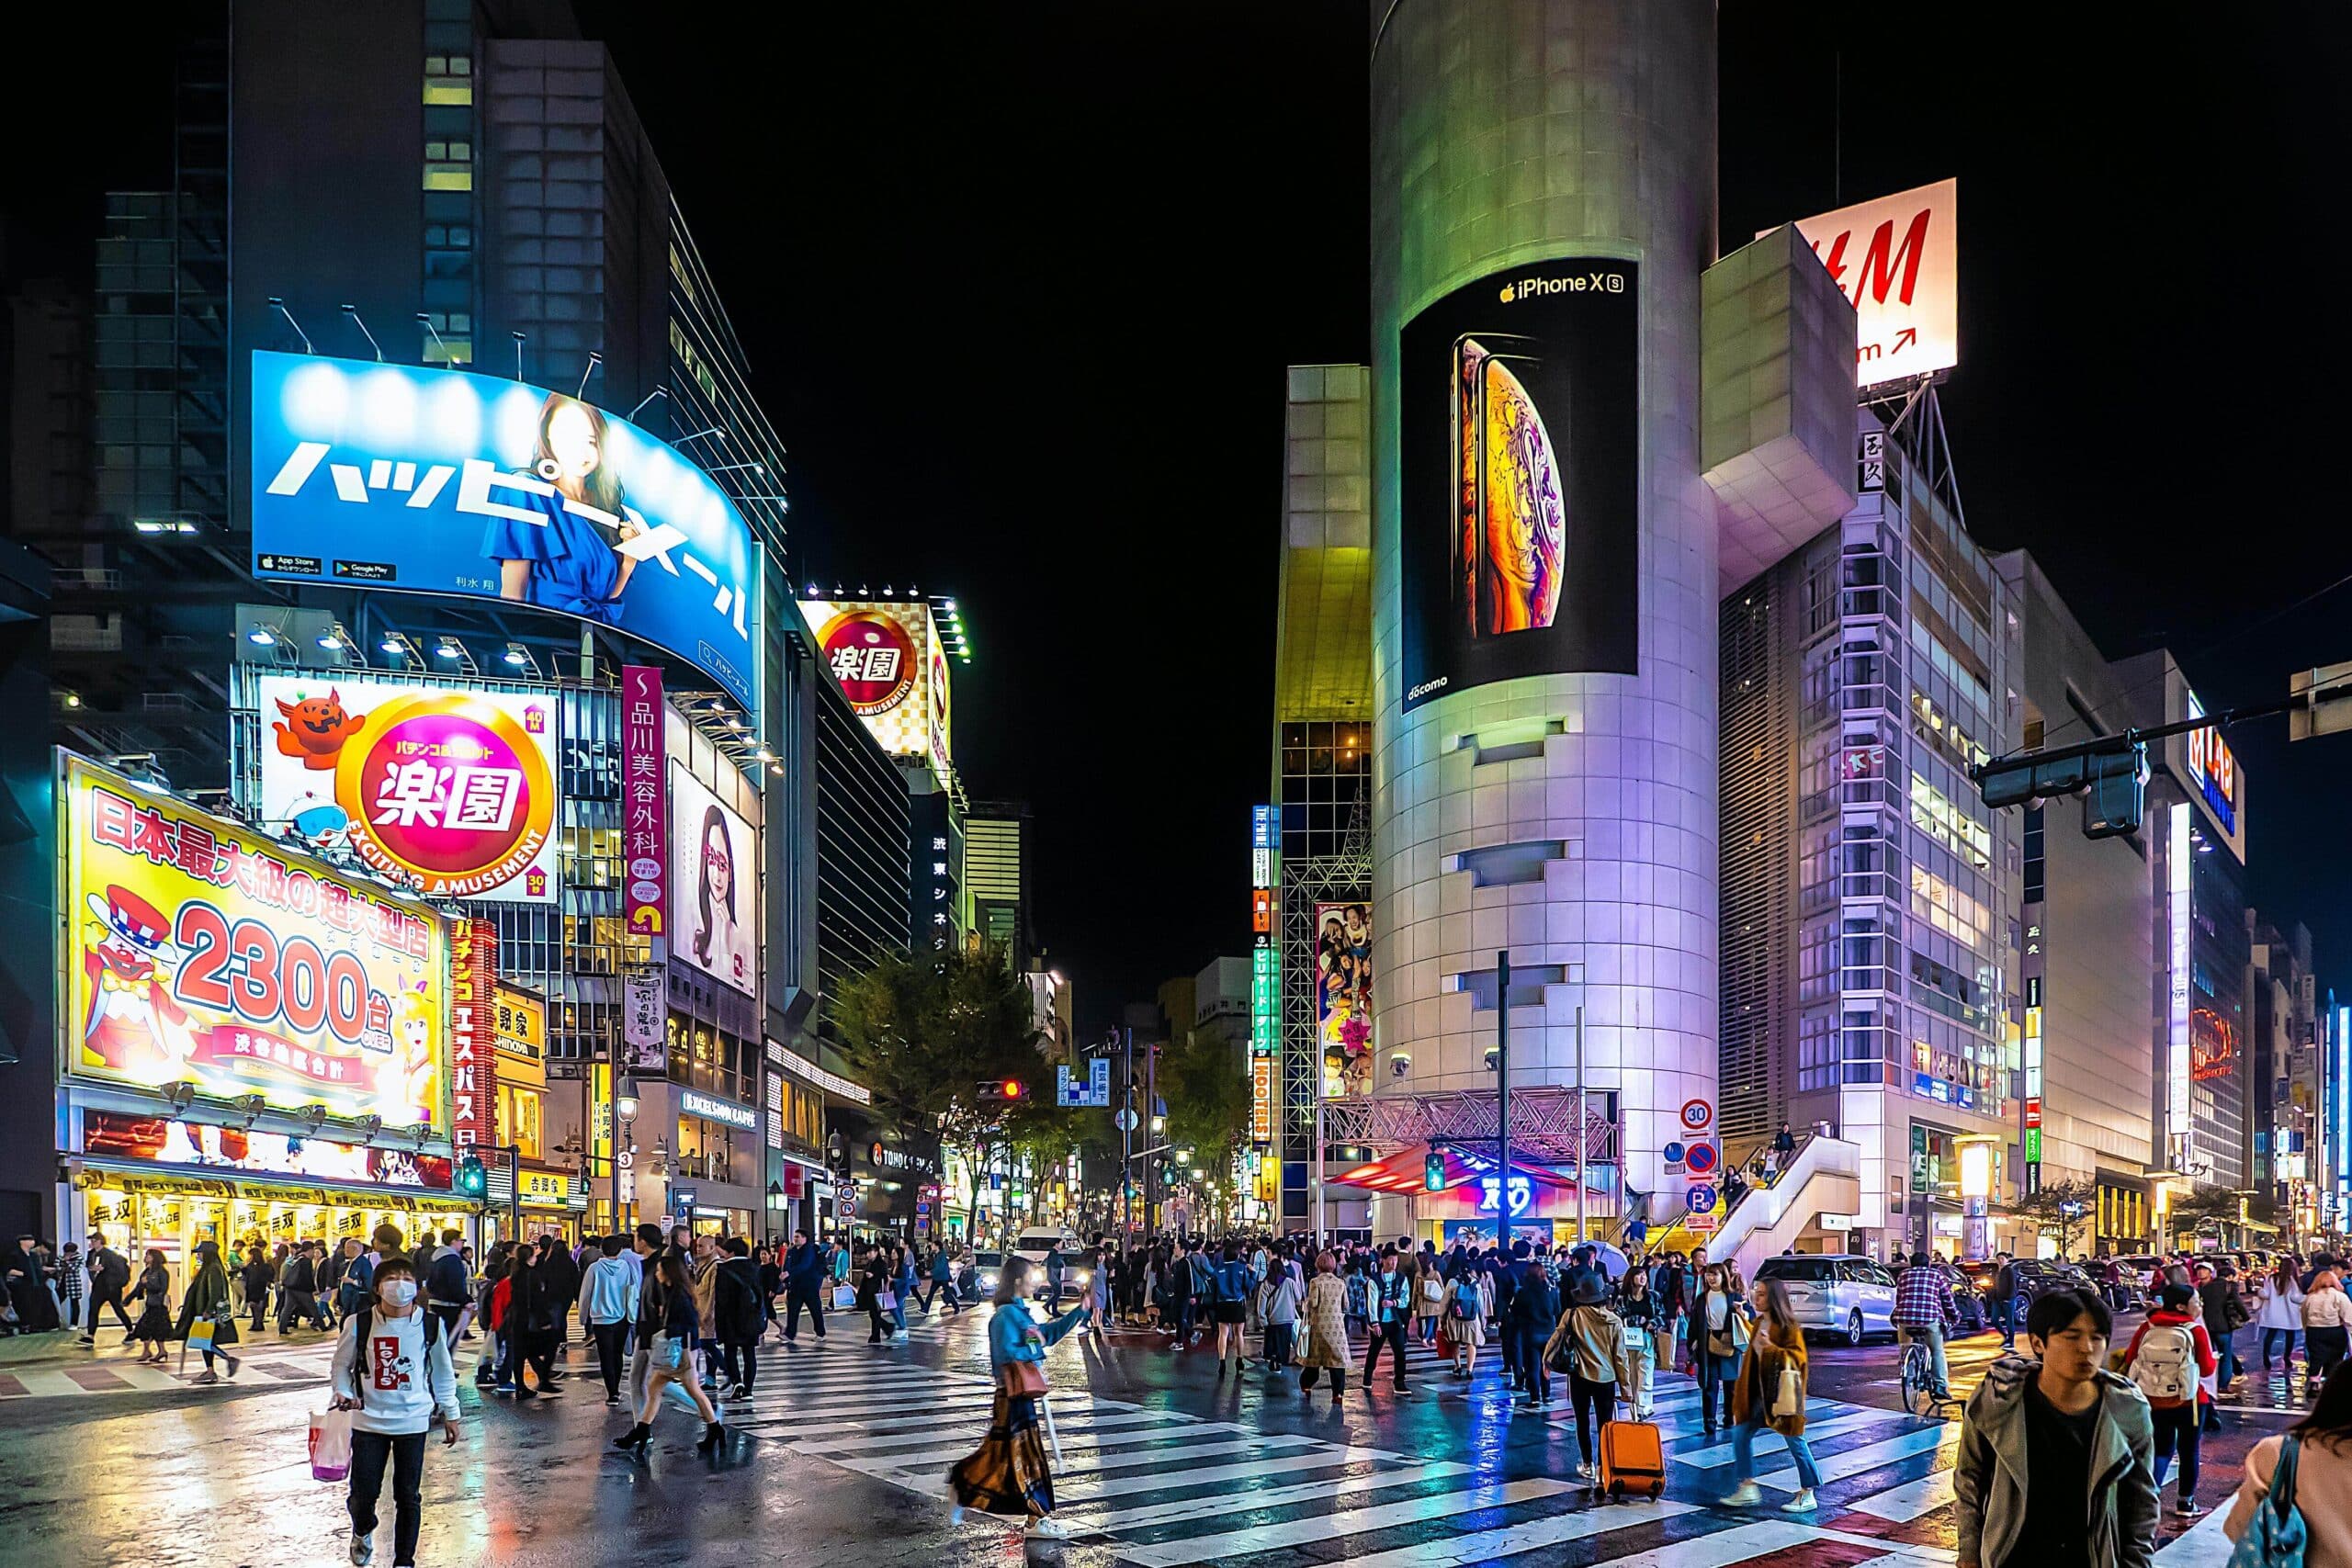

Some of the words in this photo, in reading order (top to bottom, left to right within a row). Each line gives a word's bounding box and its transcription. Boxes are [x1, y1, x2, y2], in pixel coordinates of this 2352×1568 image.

[1518, 277, 1587, 299] iPhone
[266, 441, 749, 641] ハッピーメール
[277, 558, 293, 566] App
[294, 558, 314, 566] Store
[351, 564, 373, 573] Google
[374, 565, 388, 575] Play
[831, 646, 900, 682] 楽園
[857, 680, 912, 716] AMUSEMENT
[526, 711, 543, 724] 40
[630, 702, 659, 856] 品川美容外科
[371, 758, 522, 831] 楽園
[432, 829, 544, 895] AMUSEMENT
[93, 785, 430, 962] 日本最大級の超大型店
[528, 875, 544, 886] 30
[455, 919, 475, 1000] パチンコ
[1255, 1065, 1268, 1134] HOOTERS
[1687, 1107, 1706, 1122] 30
[621, 1154, 628, 1166] 3
[884, 1149, 903, 1168] TOHO
[145, 1183, 172, 1191] NEXT
[531, 1177, 558, 1192] 吉野家
[94, 1199, 130, 1222] 無双
[1693, 1192, 1704, 1211] P
[143, 1212, 180, 1231] STAGE
